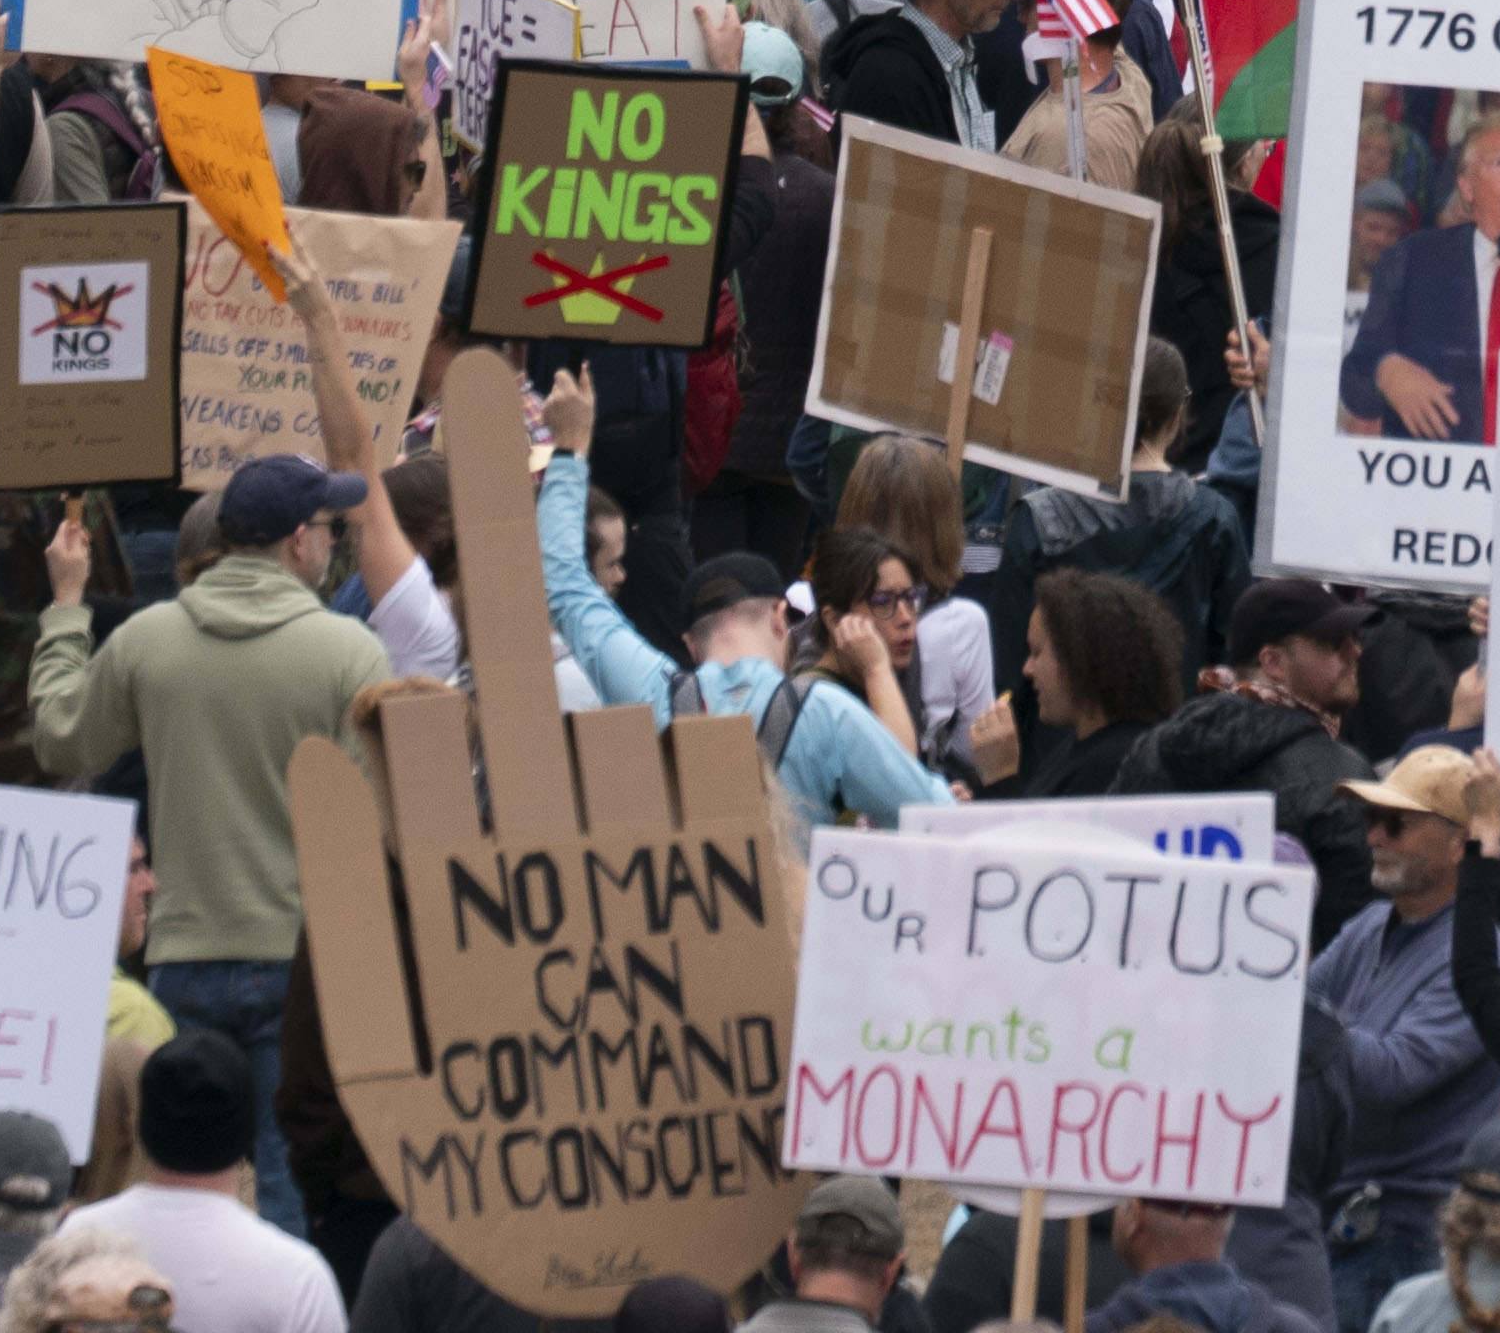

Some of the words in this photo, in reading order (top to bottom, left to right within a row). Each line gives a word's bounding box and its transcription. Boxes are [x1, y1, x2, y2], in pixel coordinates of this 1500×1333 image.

[1354, 5, 1476, 54] 1776
[565, 88, 667, 163] NO
[446, 849, 567, 951] NO
[586, 837, 768, 933] MAN
[441, 1015, 783, 1121] COMMAND
[861, 1008, 1056, 1064] wants
[1096, 1027, 1137, 1071] a
[789, 1062, 1281, 1194] MONARCHY
